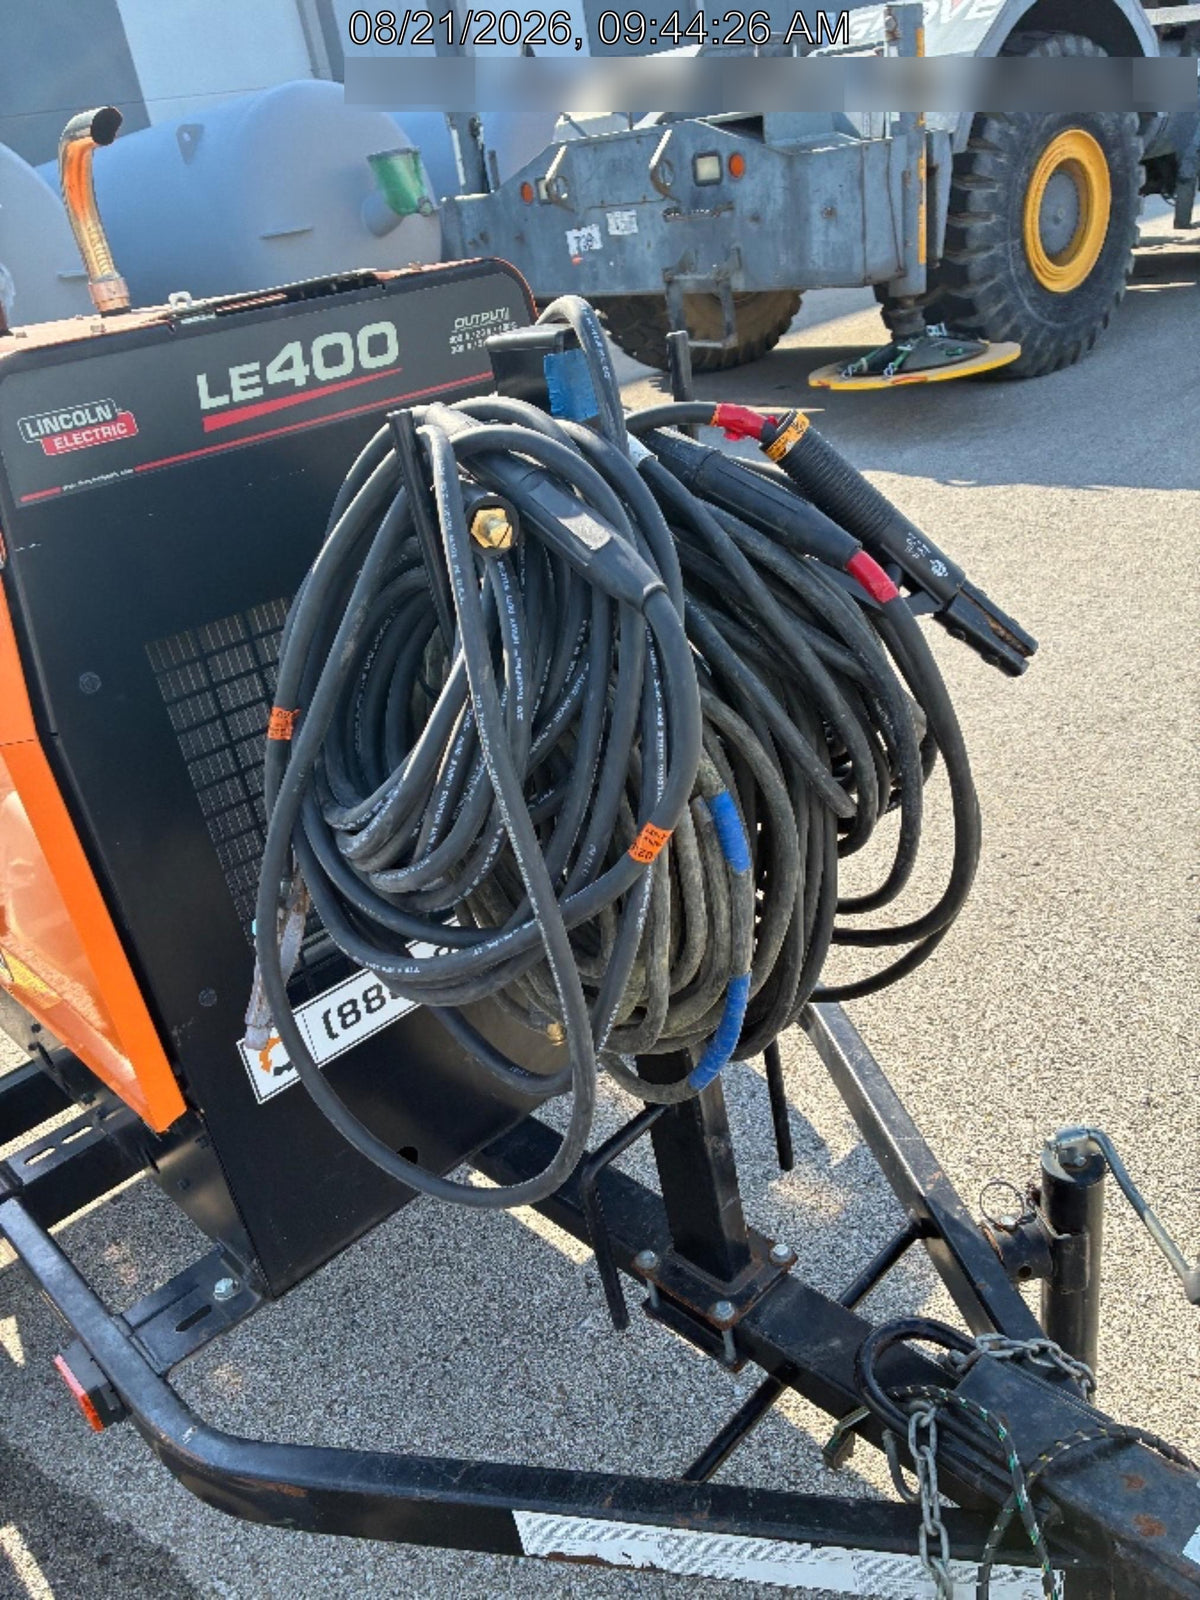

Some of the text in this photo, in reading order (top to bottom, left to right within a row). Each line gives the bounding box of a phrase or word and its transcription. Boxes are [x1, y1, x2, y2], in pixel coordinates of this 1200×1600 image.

[454, 307, 506, 330] OUTPUT
[196, 321, 399, 410] LE400
[25, 404, 113, 438] LINCOLN
[53, 422, 128, 450] ELECTRIC
[321, 982, 399, 1041] (88
